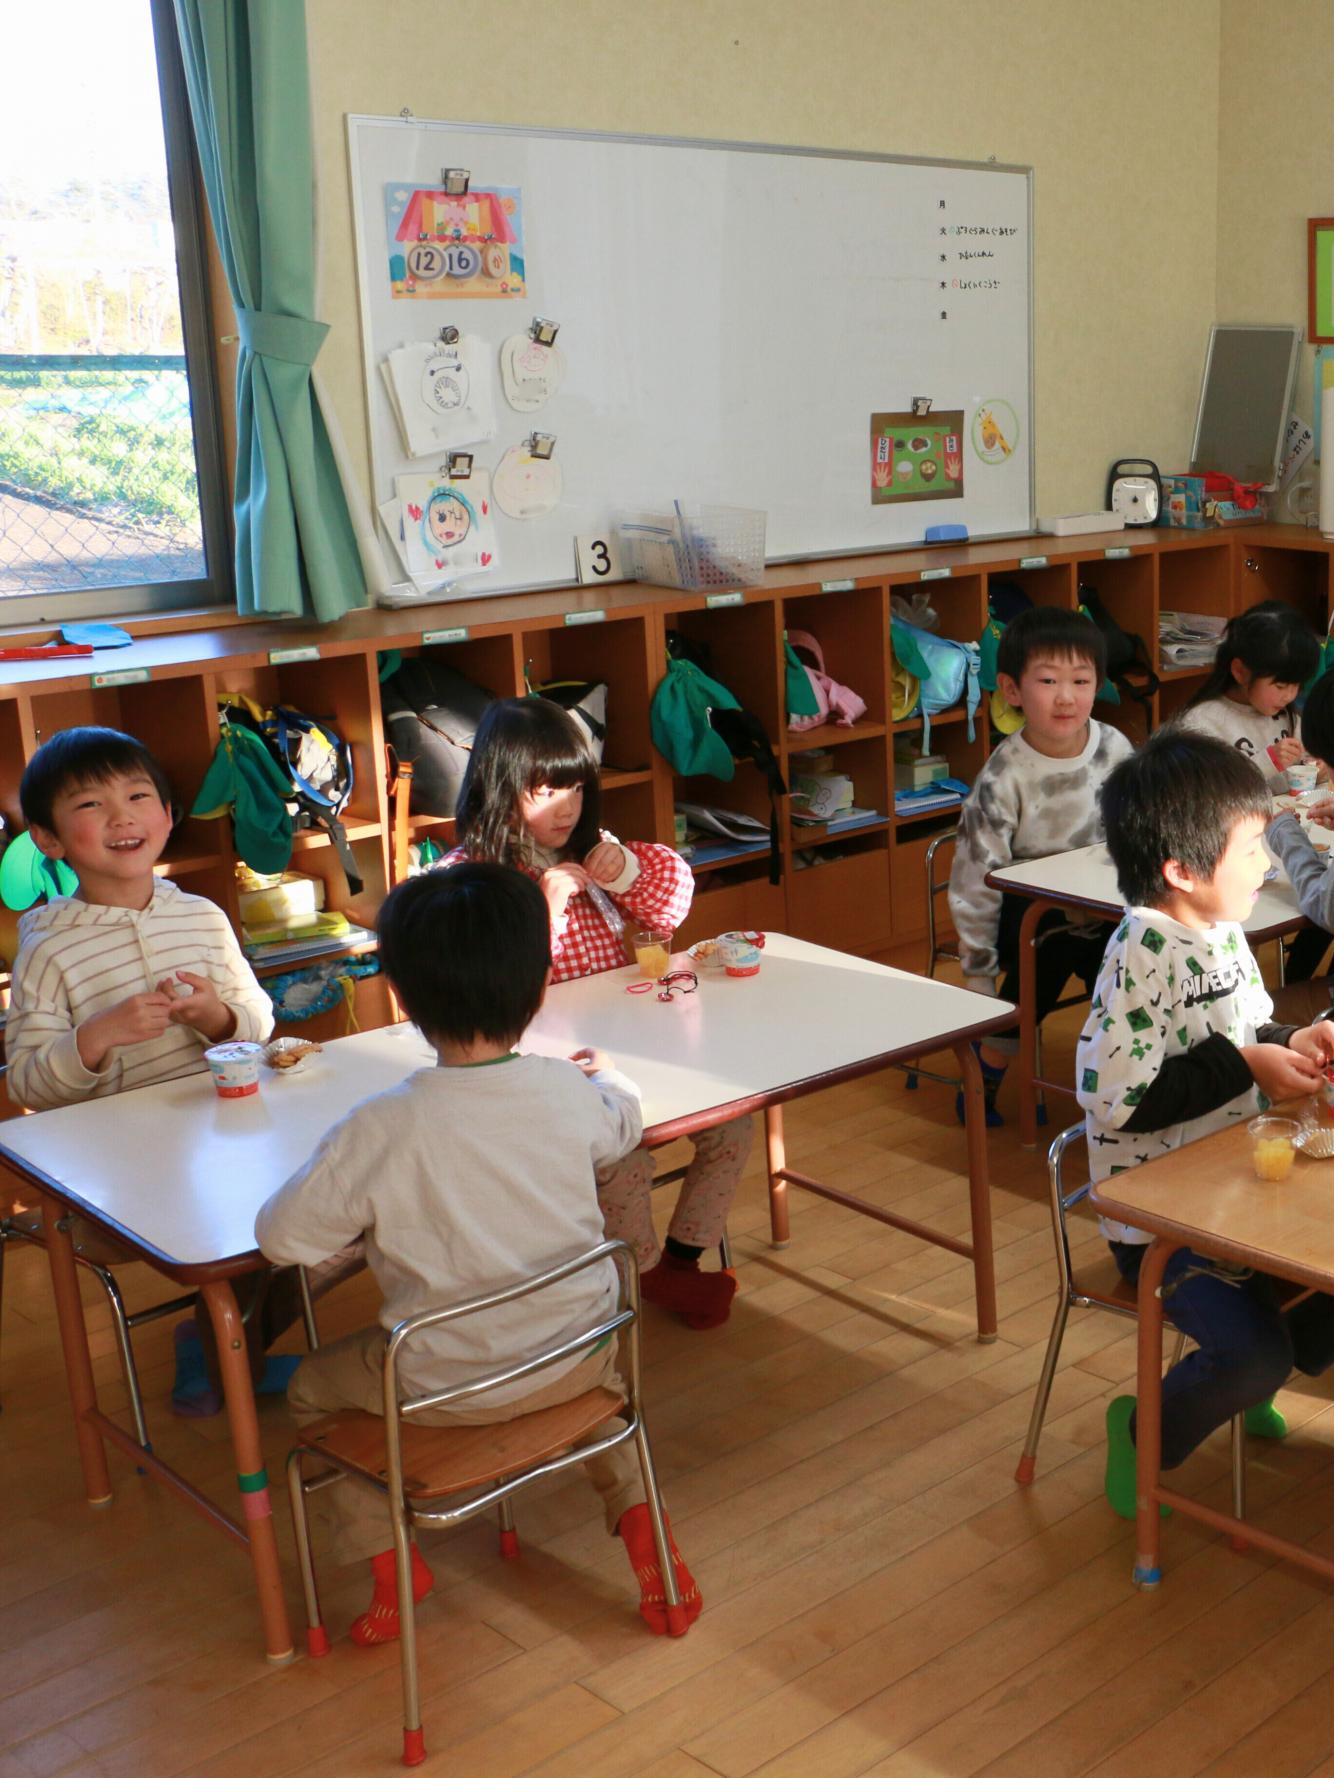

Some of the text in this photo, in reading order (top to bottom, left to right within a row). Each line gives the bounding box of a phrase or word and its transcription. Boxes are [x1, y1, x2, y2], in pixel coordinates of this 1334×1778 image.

[416, 251, 470, 271] 12 16
[591, 540, 611, 575] 3
